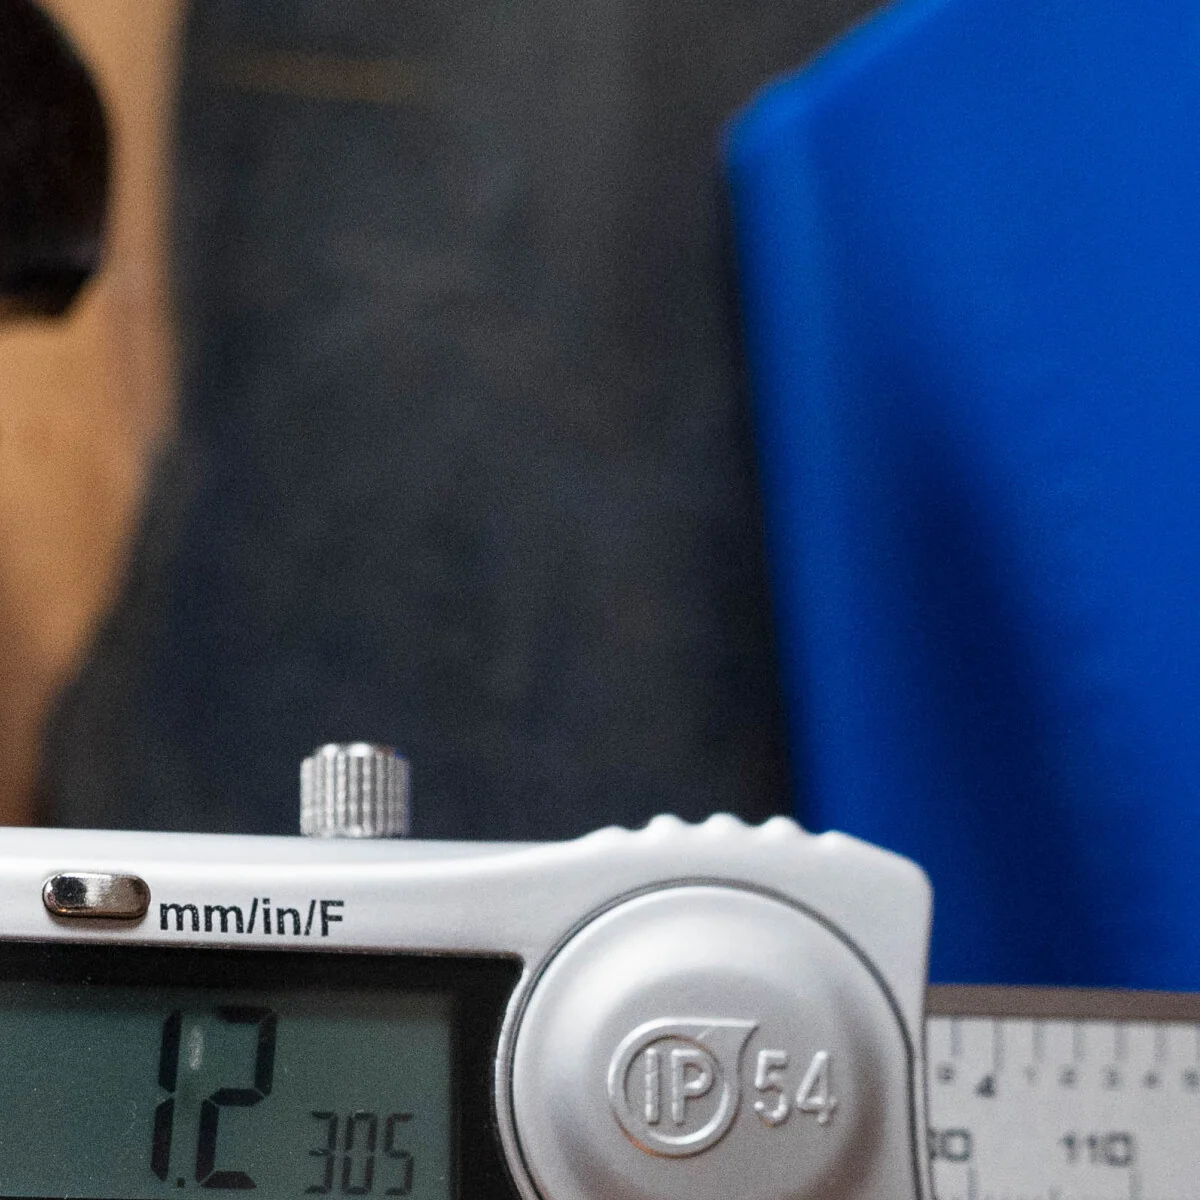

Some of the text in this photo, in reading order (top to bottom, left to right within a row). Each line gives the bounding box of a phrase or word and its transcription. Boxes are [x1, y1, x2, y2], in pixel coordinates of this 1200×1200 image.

[160, 898, 345, 937] mm/in/F
[644, 1047, 838, 1127] IP 54
